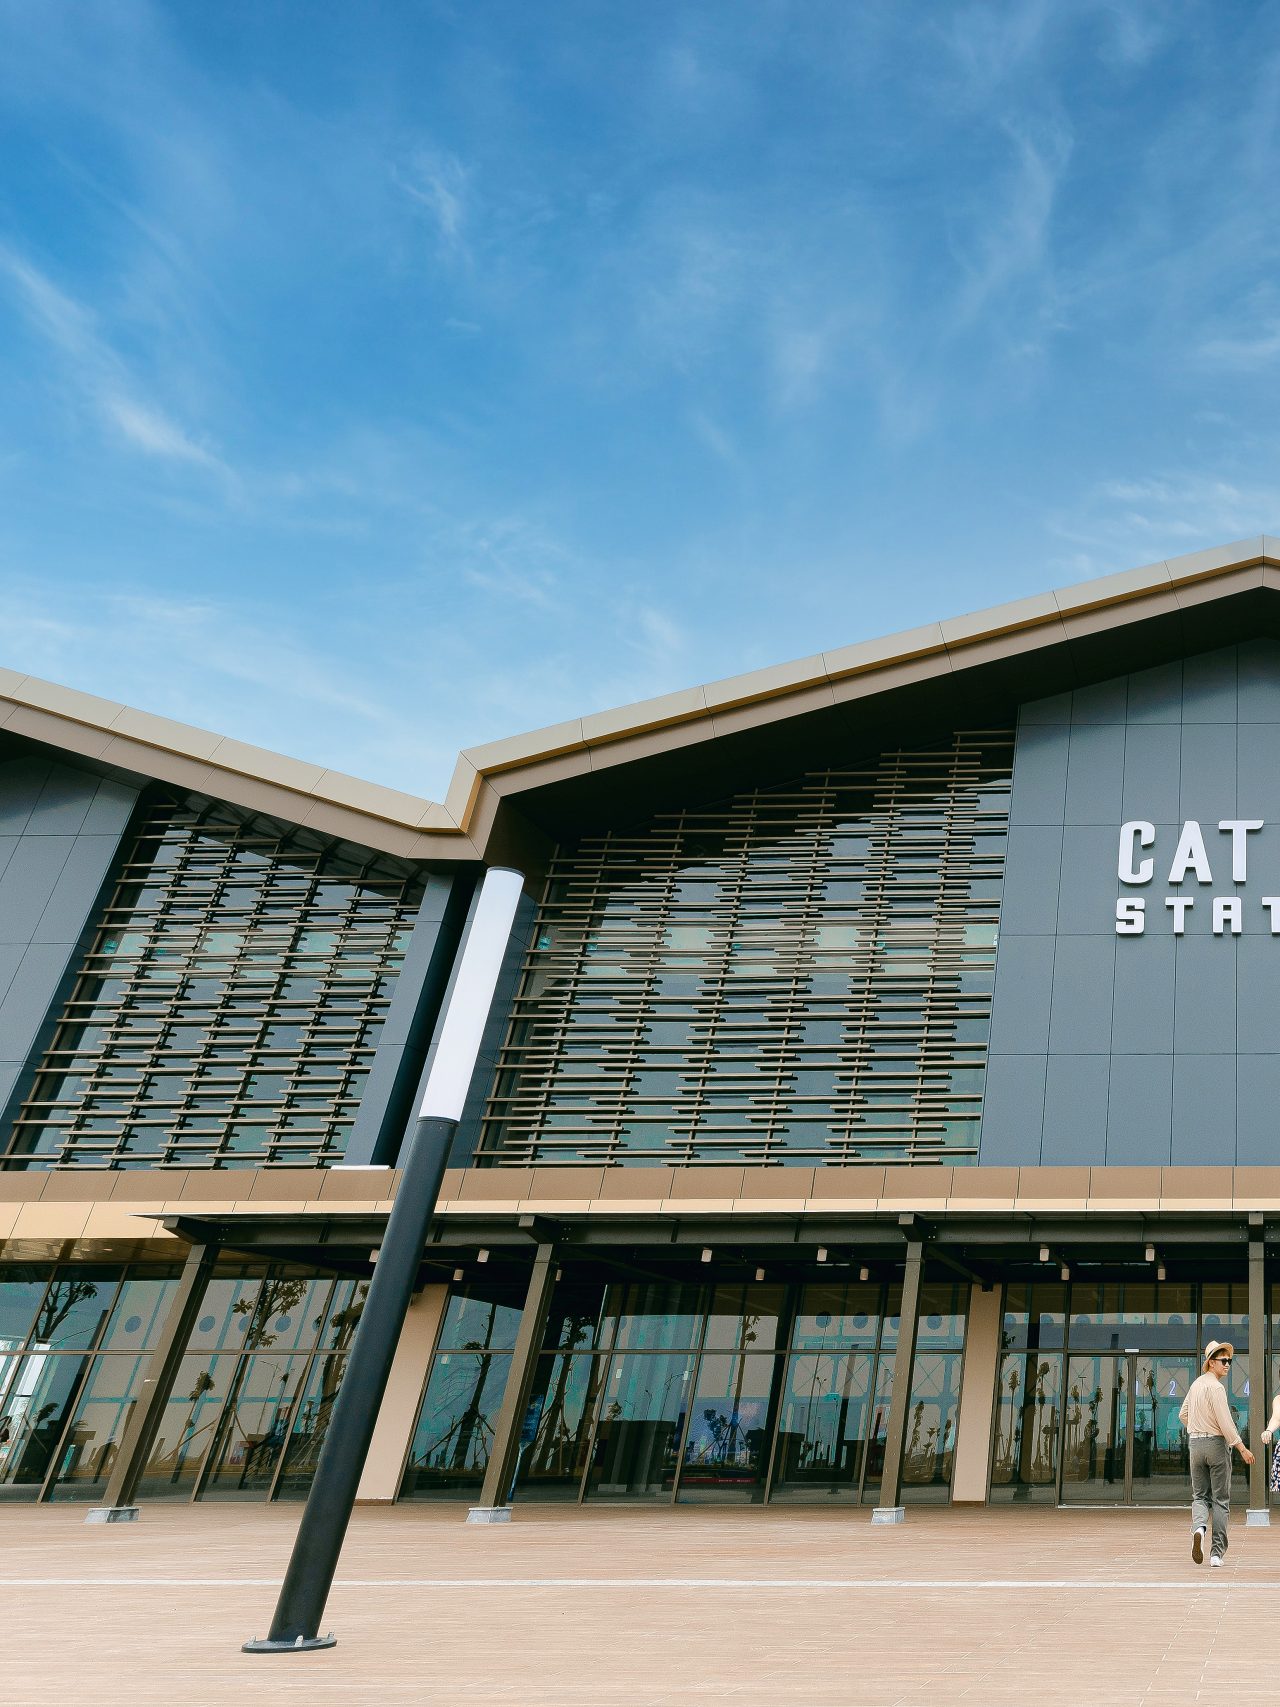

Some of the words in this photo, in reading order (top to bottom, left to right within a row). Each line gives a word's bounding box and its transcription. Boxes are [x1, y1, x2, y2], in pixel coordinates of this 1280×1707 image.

[1117, 820, 1265, 884] CAT
[1169, 1380, 1177, 1396] 2
[1243, 1380, 1250, 1396] 4
